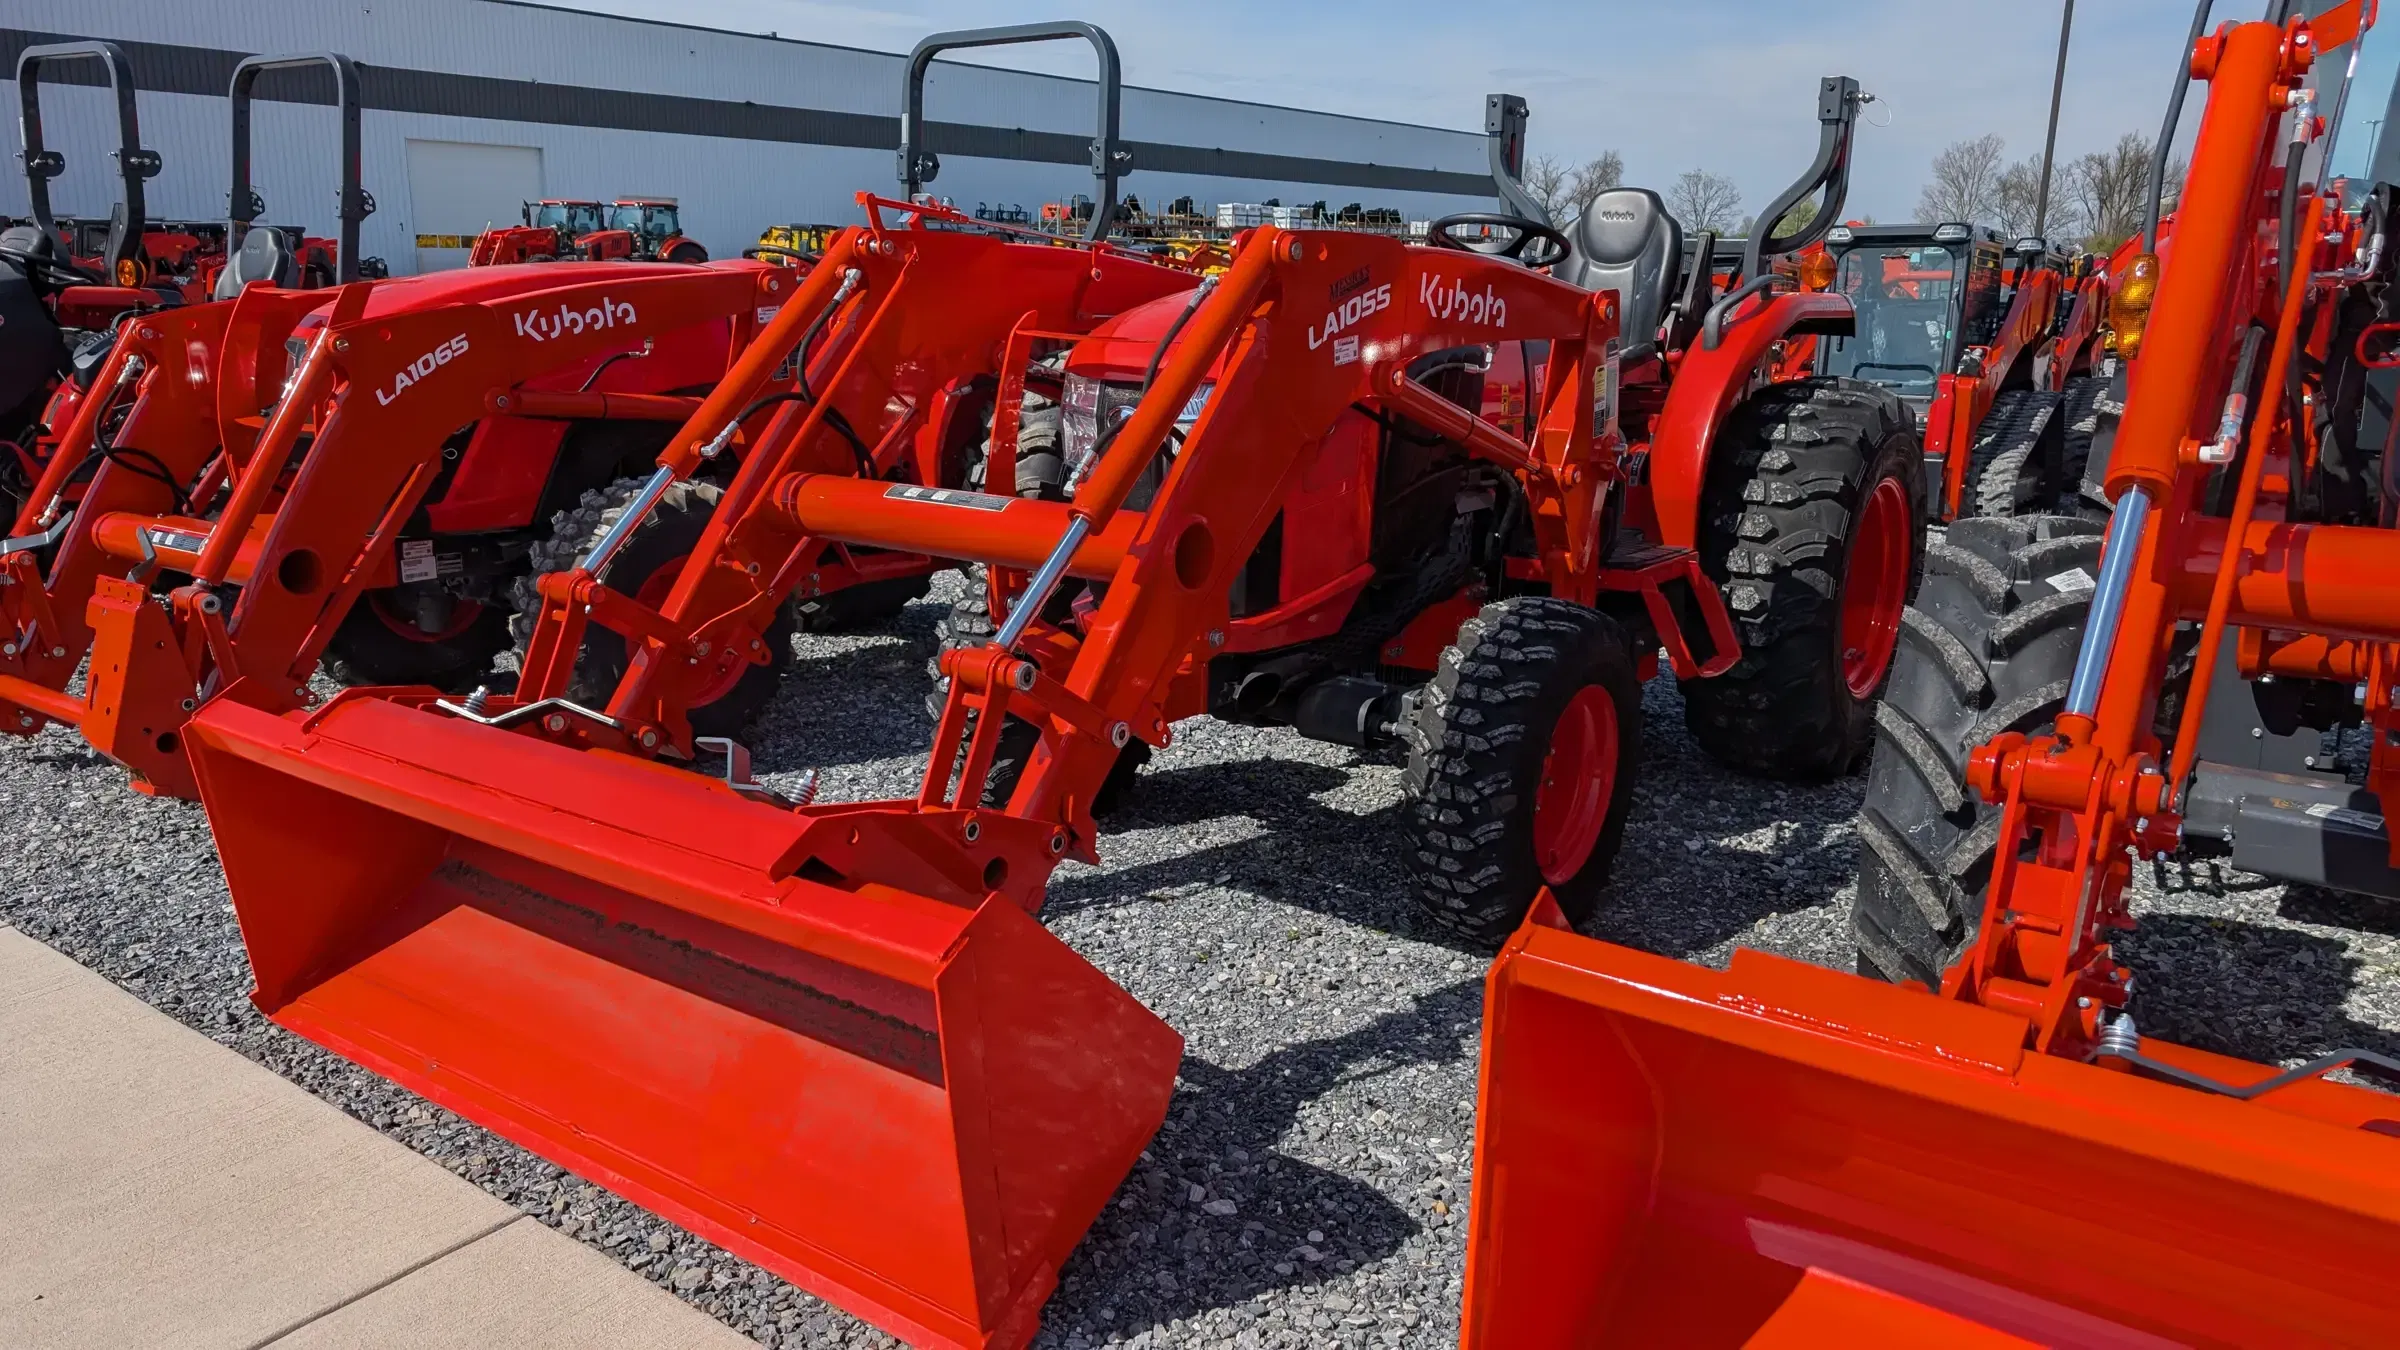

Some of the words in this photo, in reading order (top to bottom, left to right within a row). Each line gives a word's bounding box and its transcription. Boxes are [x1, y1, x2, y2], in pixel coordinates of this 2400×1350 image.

[513, 296, 637, 342] Kubota
[1308, 283, 1391, 350] LA1055
[1419, 272, 1506, 328] Kubota
[375, 332, 469, 406] LA1065
